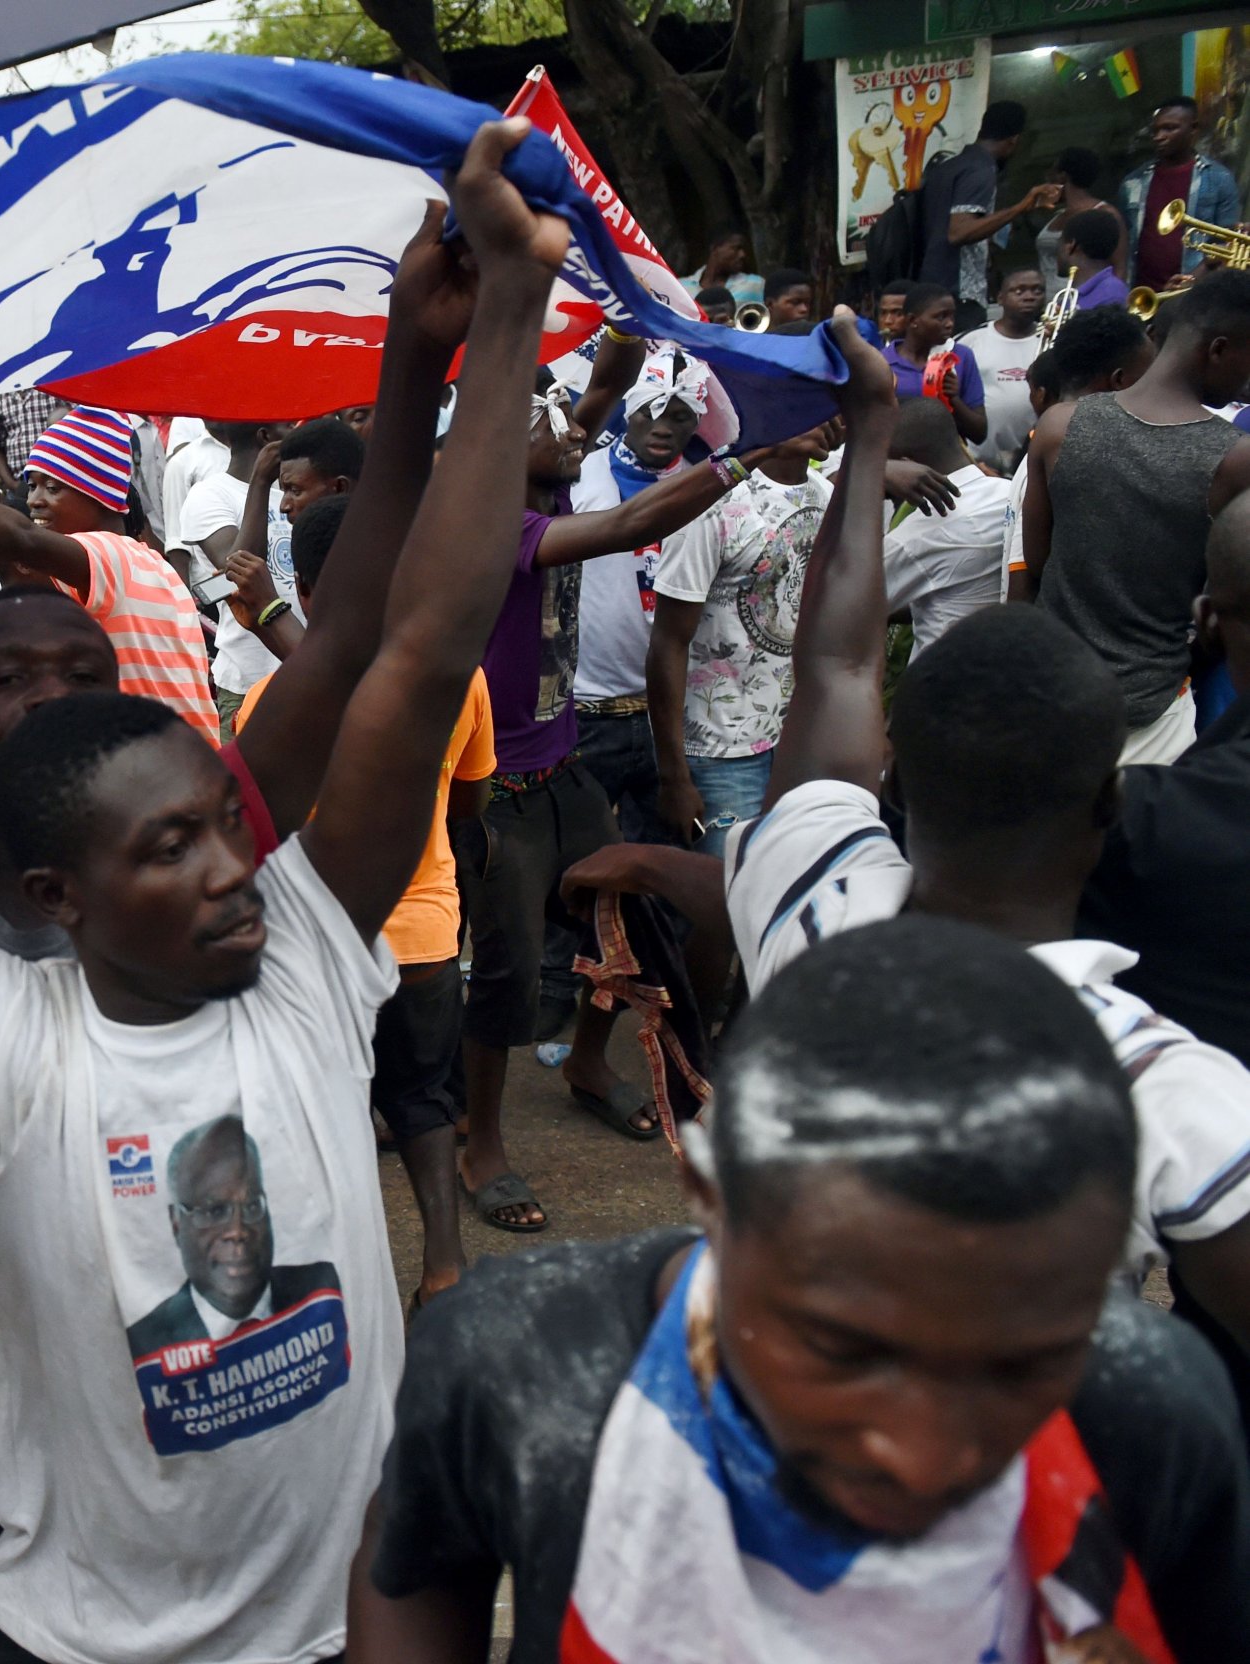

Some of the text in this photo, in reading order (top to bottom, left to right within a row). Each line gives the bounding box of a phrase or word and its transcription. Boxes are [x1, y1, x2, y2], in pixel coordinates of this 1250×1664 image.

[853, 59, 975, 92] SERVICE
[113, 1183, 157, 1199] POWER
[152, 1322, 335, 1410] K. T. HAMMOND
[163, 1343, 213, 1372] VOTE
[171, 1353, 329, 1423] ADANSI ASOKWA
[184, 1371, 323, 1436] CONSTITUENCY
